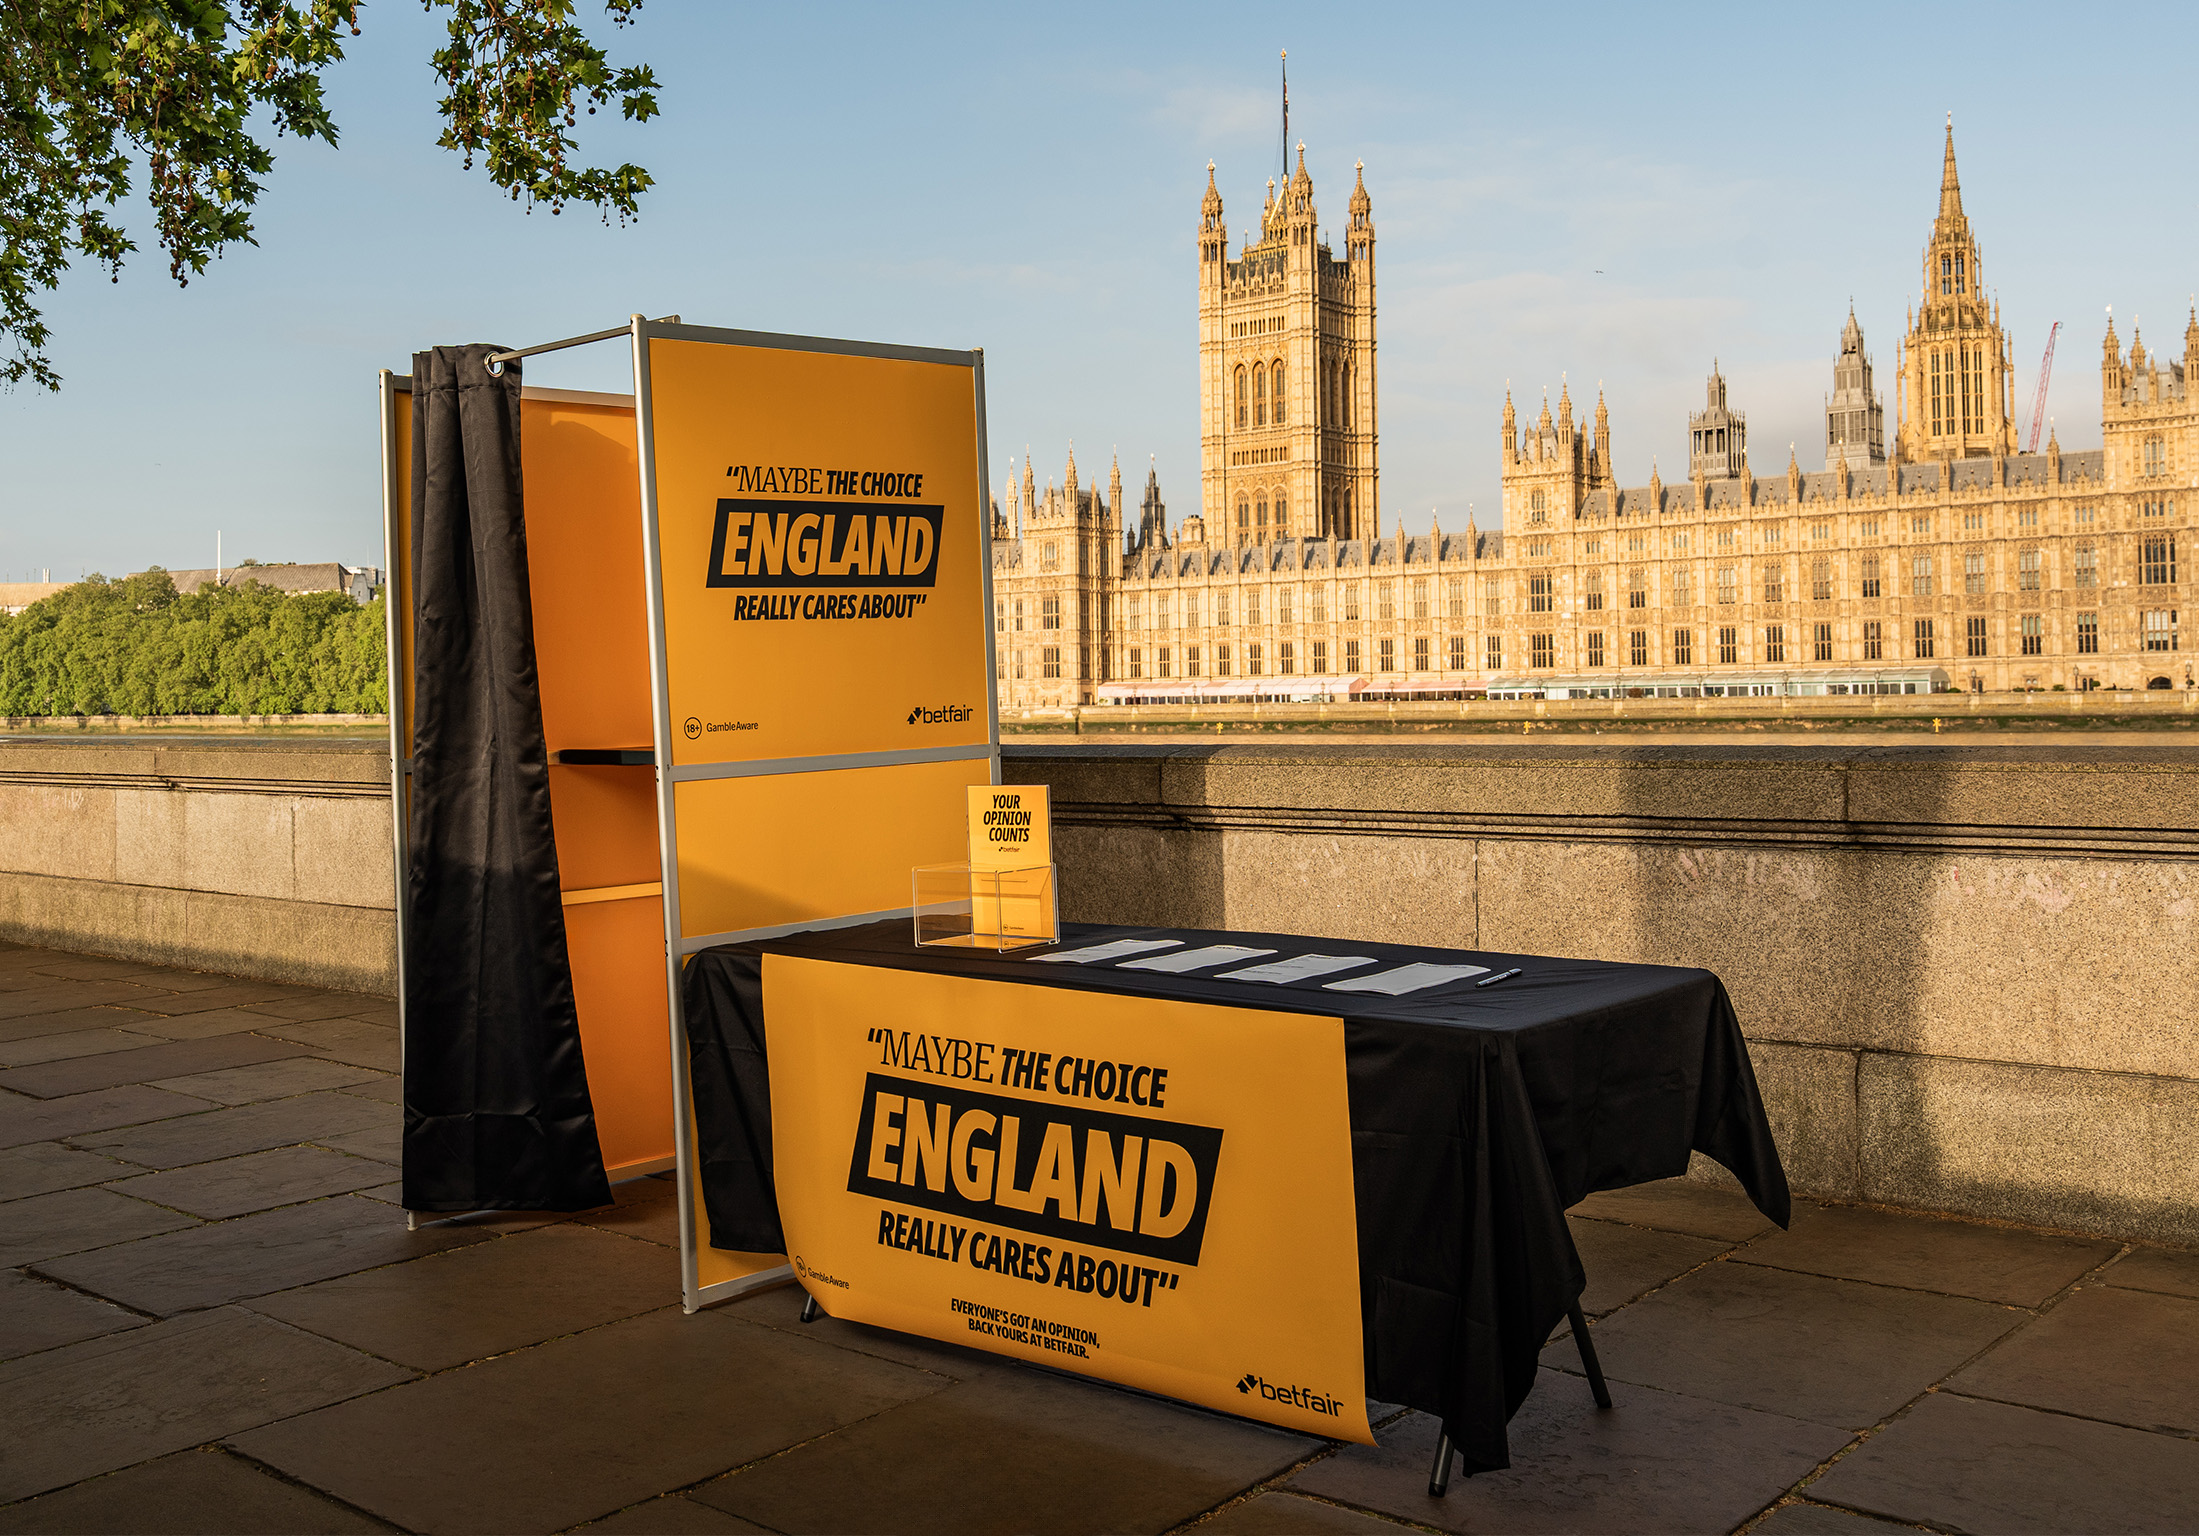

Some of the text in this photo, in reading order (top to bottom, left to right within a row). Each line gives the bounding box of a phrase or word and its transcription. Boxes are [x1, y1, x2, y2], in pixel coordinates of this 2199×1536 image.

[726, 465, 923, 498] “MAYBE THE CHOICE
[721, 511, 934, 576] ENGLAND
[734, 594, 927, 620] REALLY CARES ABOUT”
[706, 721, 759, 732] GambleAware
[923, 704, 974, 724] betfair
[983, 811, 1032, 826] OPINION
[992, 795, 1021, 809] YOUR
[989, 827, 1030, 842] COUNTS
[867, 1027, 1168, 1108] “MAYBE THE CHOICE
[867, 1091, 1198, 1239] ENGLAND
[877, 1209, 1180, 1308] REALLY CARES ABOUT”
[808, 1267, 849, 1289] GambleAware
[951, 1298, 1100, 1349] EVERYONE’S GOT AN OPINION,
[968, 1317, 1090, 1359] BACK YOURS AT BETFAIR.
[1258, 1376, 1344, 1417] betfair
